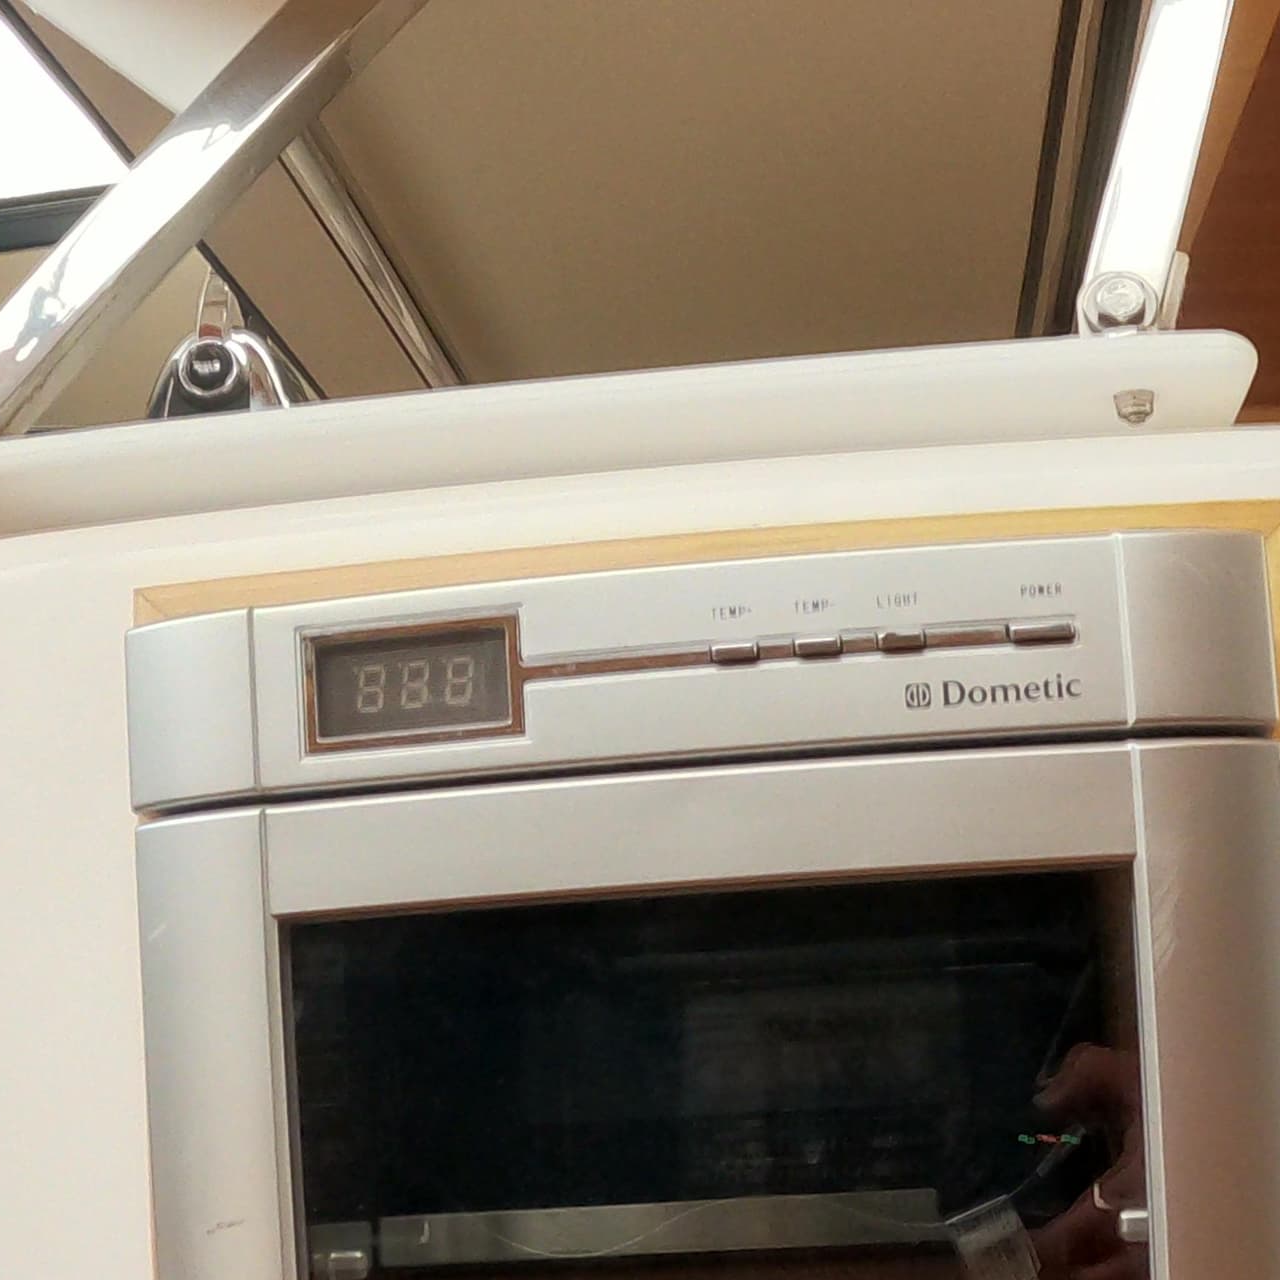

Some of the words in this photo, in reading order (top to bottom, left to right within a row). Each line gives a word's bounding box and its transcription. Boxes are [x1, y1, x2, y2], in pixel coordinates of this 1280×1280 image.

[1020, 583, 1062, 597] POWER
[876, 592, 918, 608] LIGHT
[942, 673, 1082, 707] Dometic
